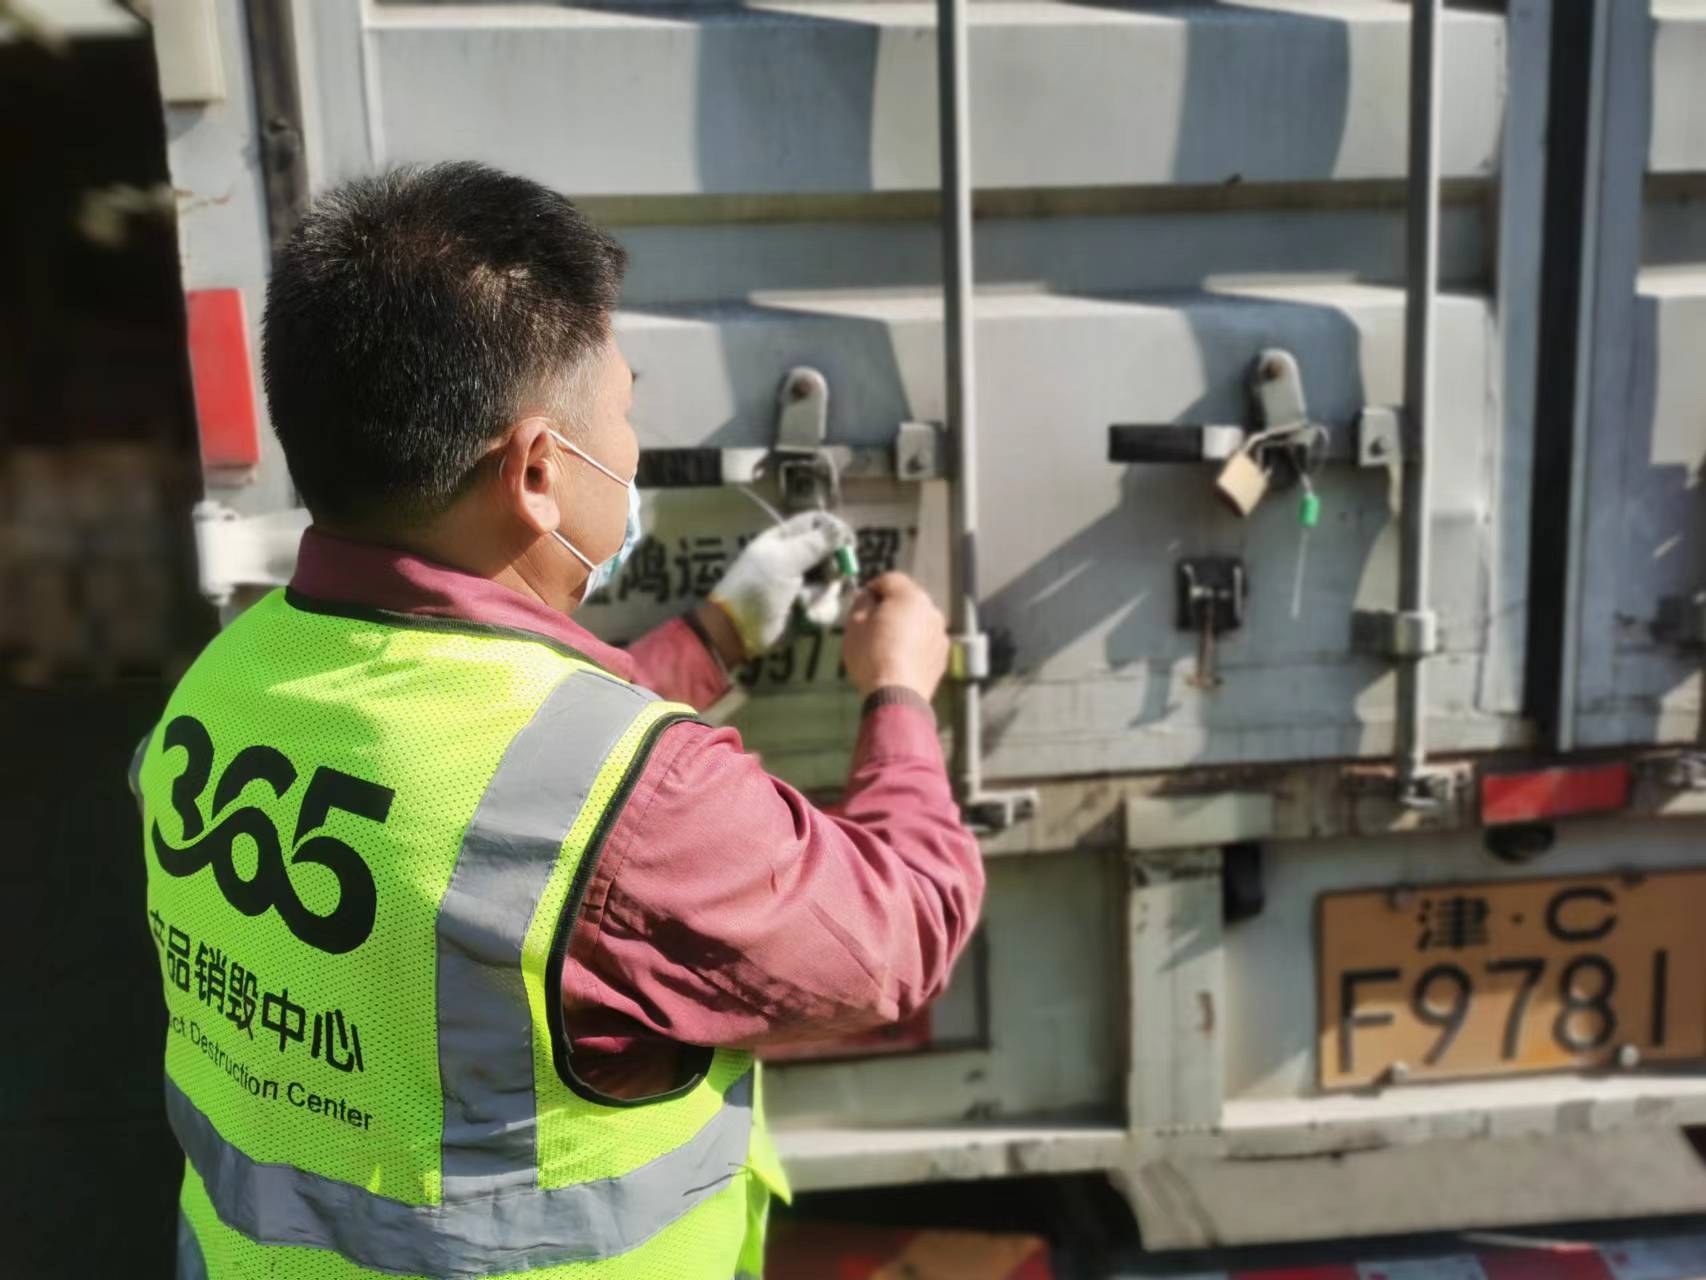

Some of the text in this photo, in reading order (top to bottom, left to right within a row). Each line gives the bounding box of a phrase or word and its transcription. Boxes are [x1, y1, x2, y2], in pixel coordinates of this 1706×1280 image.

[151, 714, 396, 955] 365
[1338, 949, 1669, 1074] F9781
[190, 1020, 279, 1101] Destruction
[287, 1081, 373, 1130] Center
